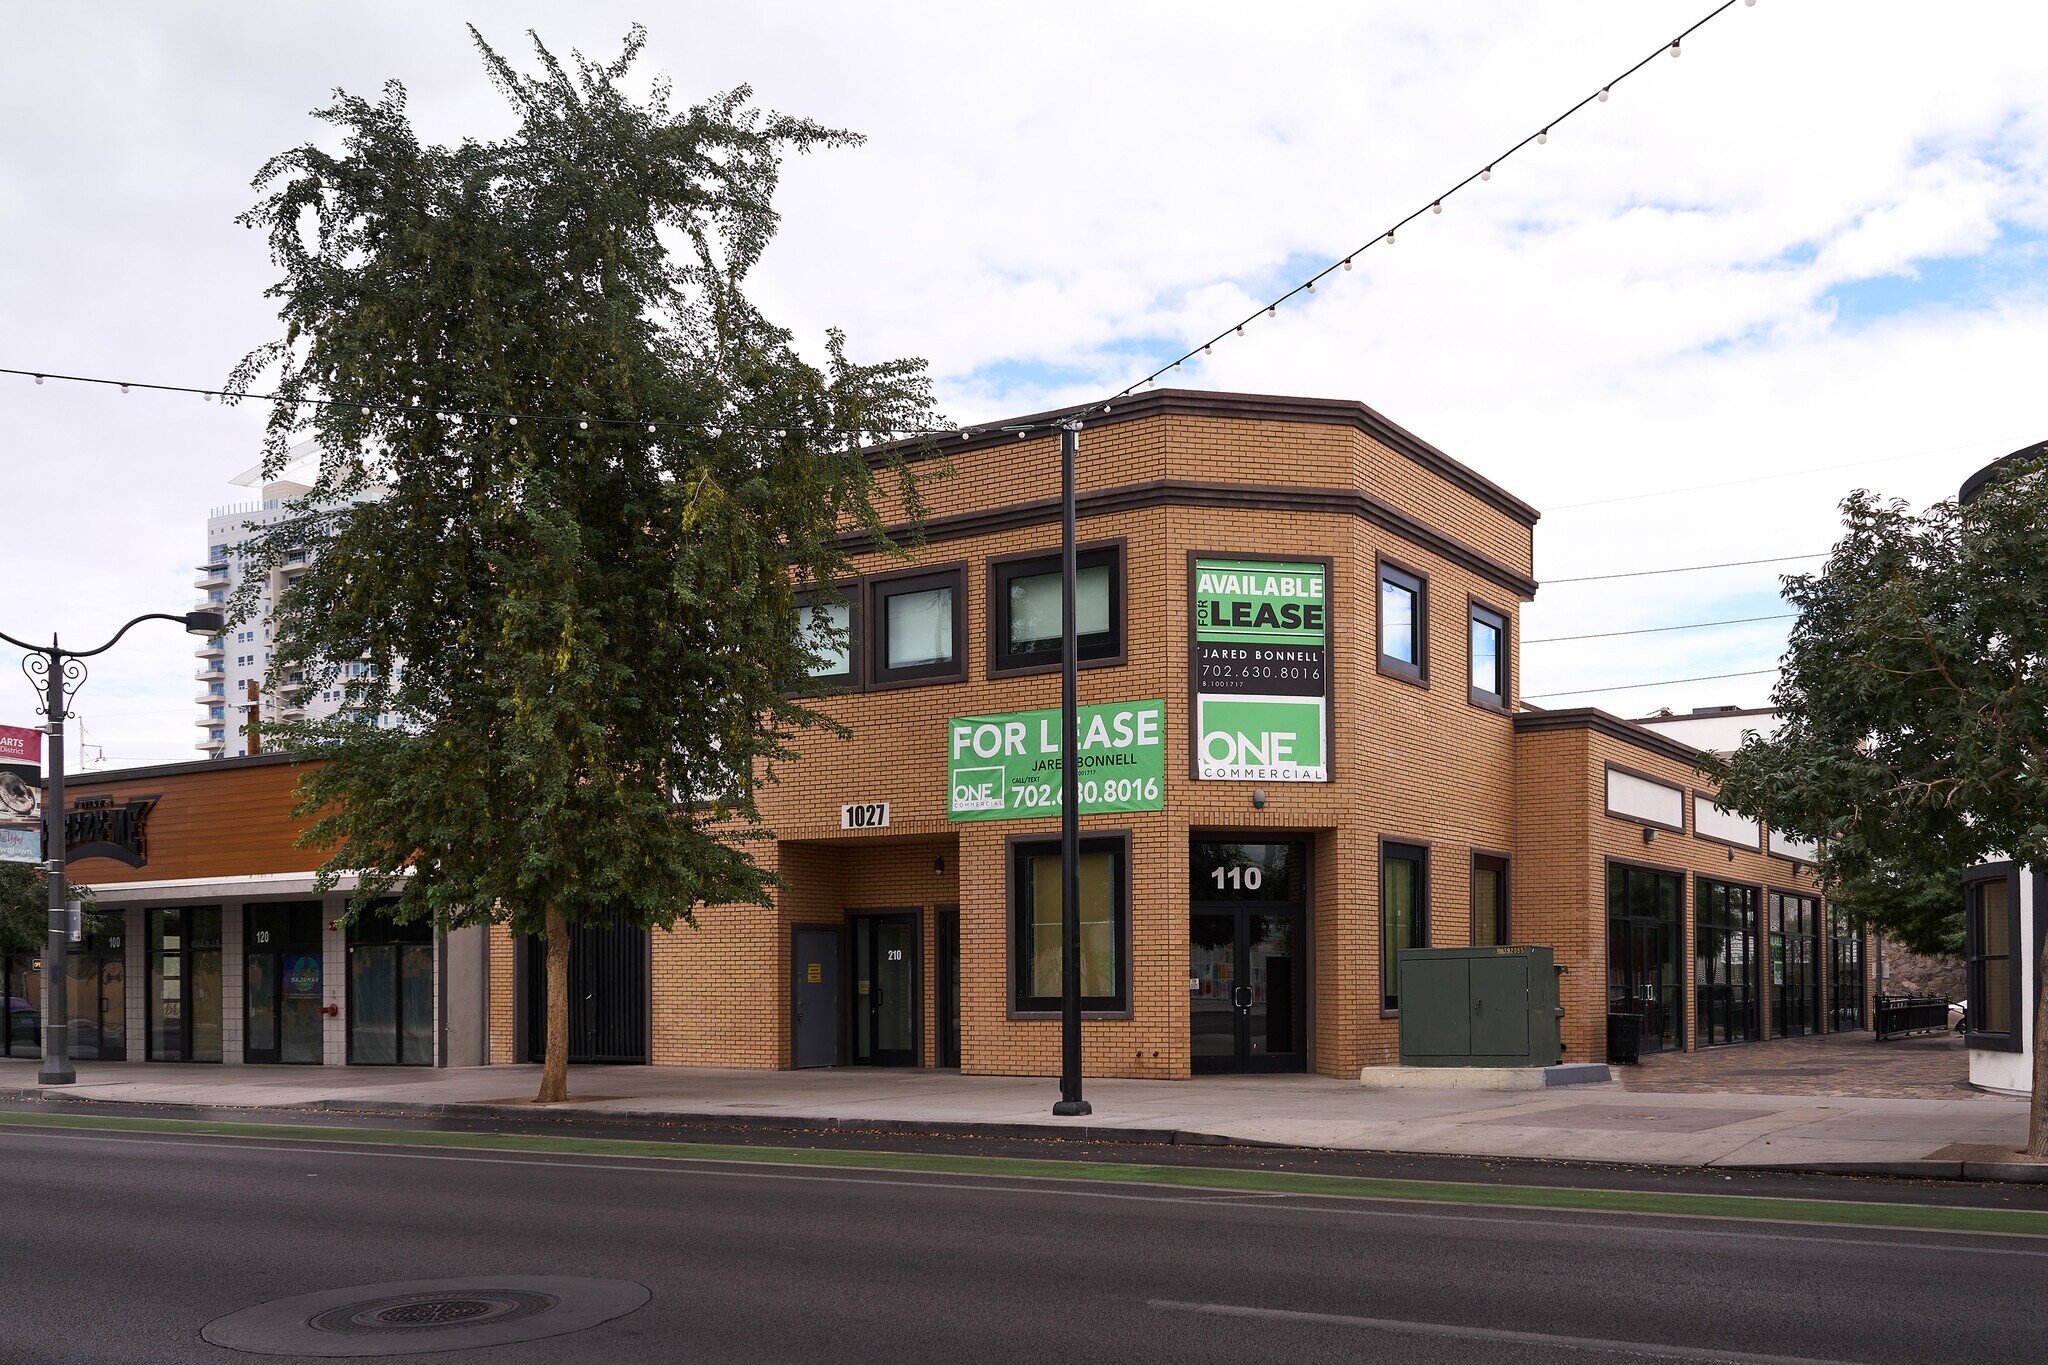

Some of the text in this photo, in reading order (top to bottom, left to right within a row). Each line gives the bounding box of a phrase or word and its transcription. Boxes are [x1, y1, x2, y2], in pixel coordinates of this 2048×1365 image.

[1197, 573, 1323, 598] AVAILABLE
[1198, 600, 1323, 630] FOR LEASE
[1202, 648, 1318, 662] JARED BONNELL
[1202, 664, 1320, 680] 702.630.8016
[1202, 680, 1244, 688] B.1001717
[953, 709, 1159, 760] FOR LASE
[0, 737, 24, 748] ARTS
[1200, 730, 1297, 767] ONE
[1032, 758, 1063, 772] JARE
[1012, 775, 1040, 784] CALL/TEXT
[1204, 767, 1322, 780] COMMERCIAL
[954, 783, 993, 801] ONE
[953, 800, 1003, 809] COMMERCIAL
[846, 804, 885, 827] 1027
[1211, 866, 1262, 890] 110
[109, 936, 121, 948] 100
[256, 931, 269, 943] 120
[887, 949, 902, 961] 210
